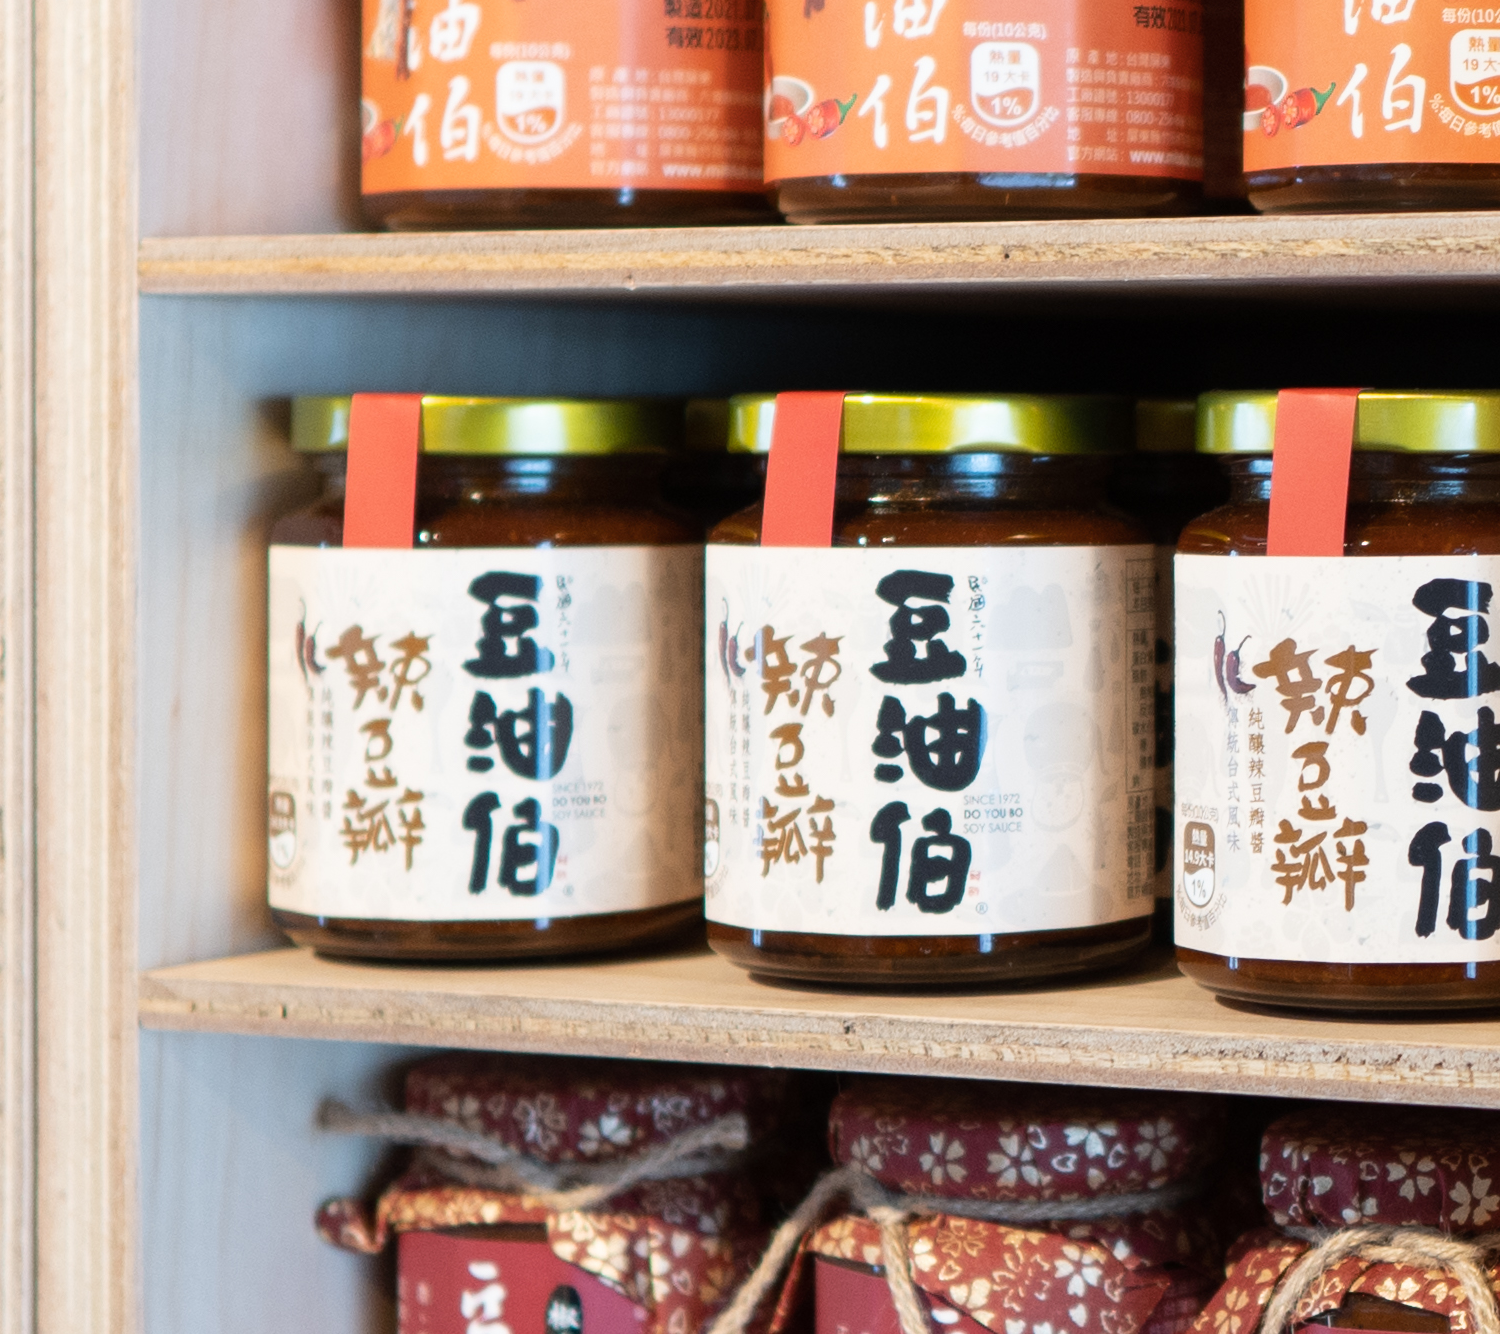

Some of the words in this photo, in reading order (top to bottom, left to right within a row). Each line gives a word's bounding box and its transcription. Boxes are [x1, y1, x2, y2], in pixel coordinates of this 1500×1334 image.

[963, 21, 1047, 40] 每份(10公克)
[1463, 58, 1479, 71] 19
[990, 97, 1022, 116] 1%
[461, 570, 574, 897] 豆油伯
[869, 569, 989, 913] 豆油伯
[325, 624, 434, 872] 辣豆瓣
[745, 624, 845, 884] 辣豆瓣
[1226, 707, 1241, 853] 傳統台式風味
[1248, 707, 1266, 854] 純釀辣豆瓣醬
[1252, 637, 1379, 912] 辣豆瓣
[552, 795, 566, 807] DO
[569, 795, 591, 807] YOU
[963, 794, 995, 805] SINCE
[998, 793, 1020, 804] 1972
[963, 808, 981, 820] DO
[985, 808, 1006, 819] YOU
[1009, 807, 1023, 818] BO
[963, 822, 985, 833] SOY
[988, 821, 1022, 833] SAUCE
[1184, 848, 1215, 867] 14.9大卡
[1191, 878, 1207, 898] 1%
